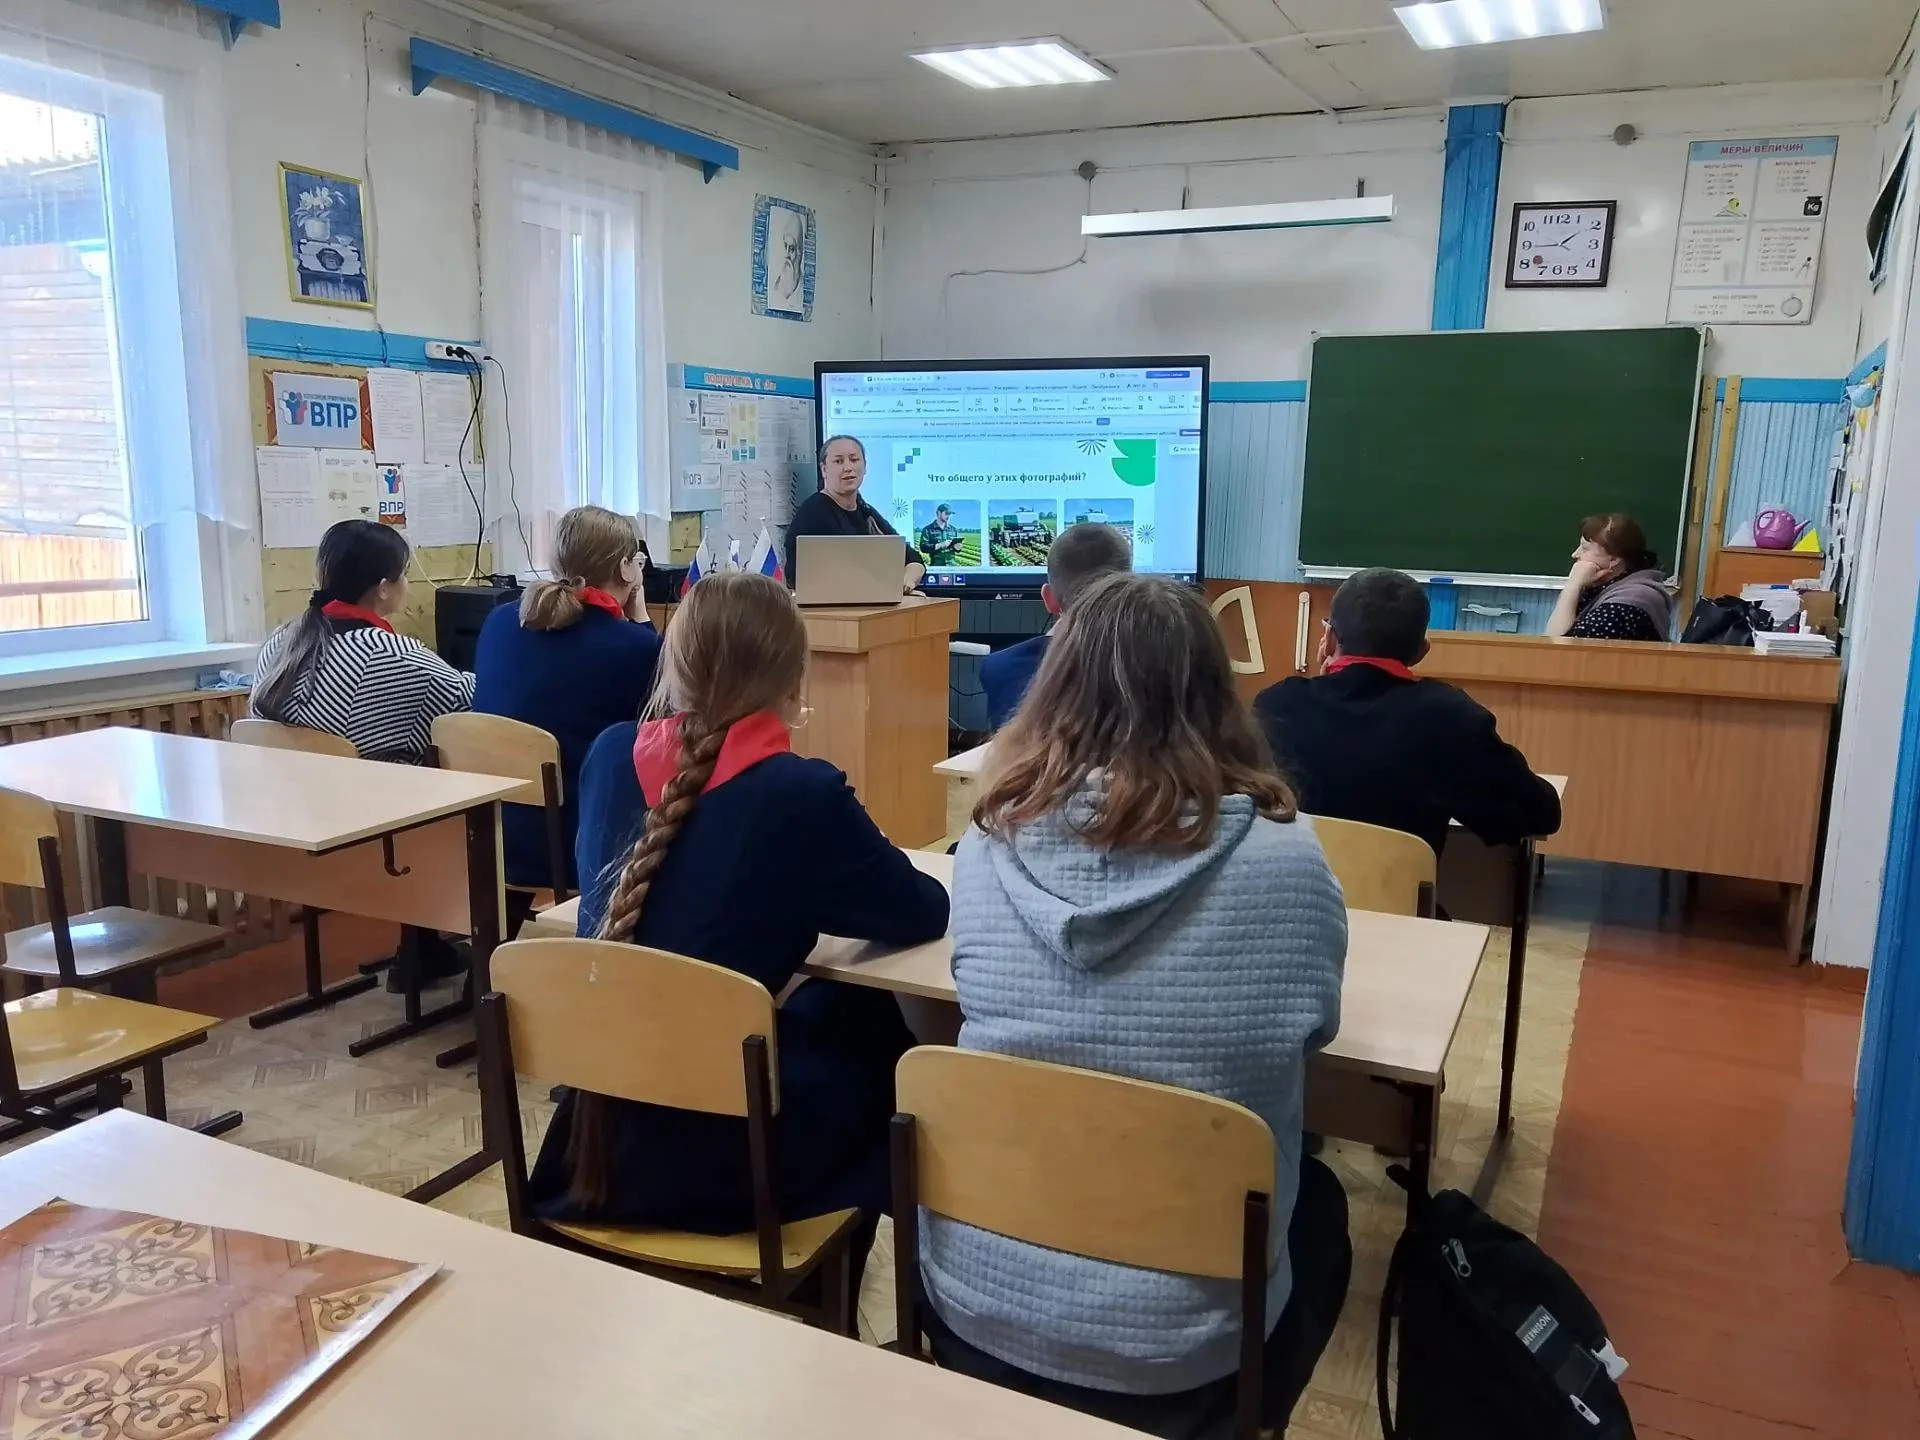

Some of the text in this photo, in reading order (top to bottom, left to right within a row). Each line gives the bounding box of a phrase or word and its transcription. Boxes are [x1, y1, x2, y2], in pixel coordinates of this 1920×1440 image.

[1720, 143, 1804, 155] МЕРЫ ВЕЛИЧИН
[1807, 203, 1820, 212] Kg
[1555, 214, 1571, 224] 12
[1576, 215, 1581, 224] 1
[1523, 221, 1536, 232] 10
[1590, 220, 1602, 231] 2
[1522, 240, 1533, 251] 9
[1588, 239, 1599, 250] 3
[1519, 258, 1530, 269] 8
[1585, 258, 1596, 269] 4
[1537, 266, 1548, 276] 7
[1552, 265, 1563, 276] 6
[1566, 265, 1578, 276] 5
[310, 401, 357, 428] ВПР
[927, 472, 1087, 484] Что общего у этих фотографий?
[379, 501, 404, 514] ВПР
